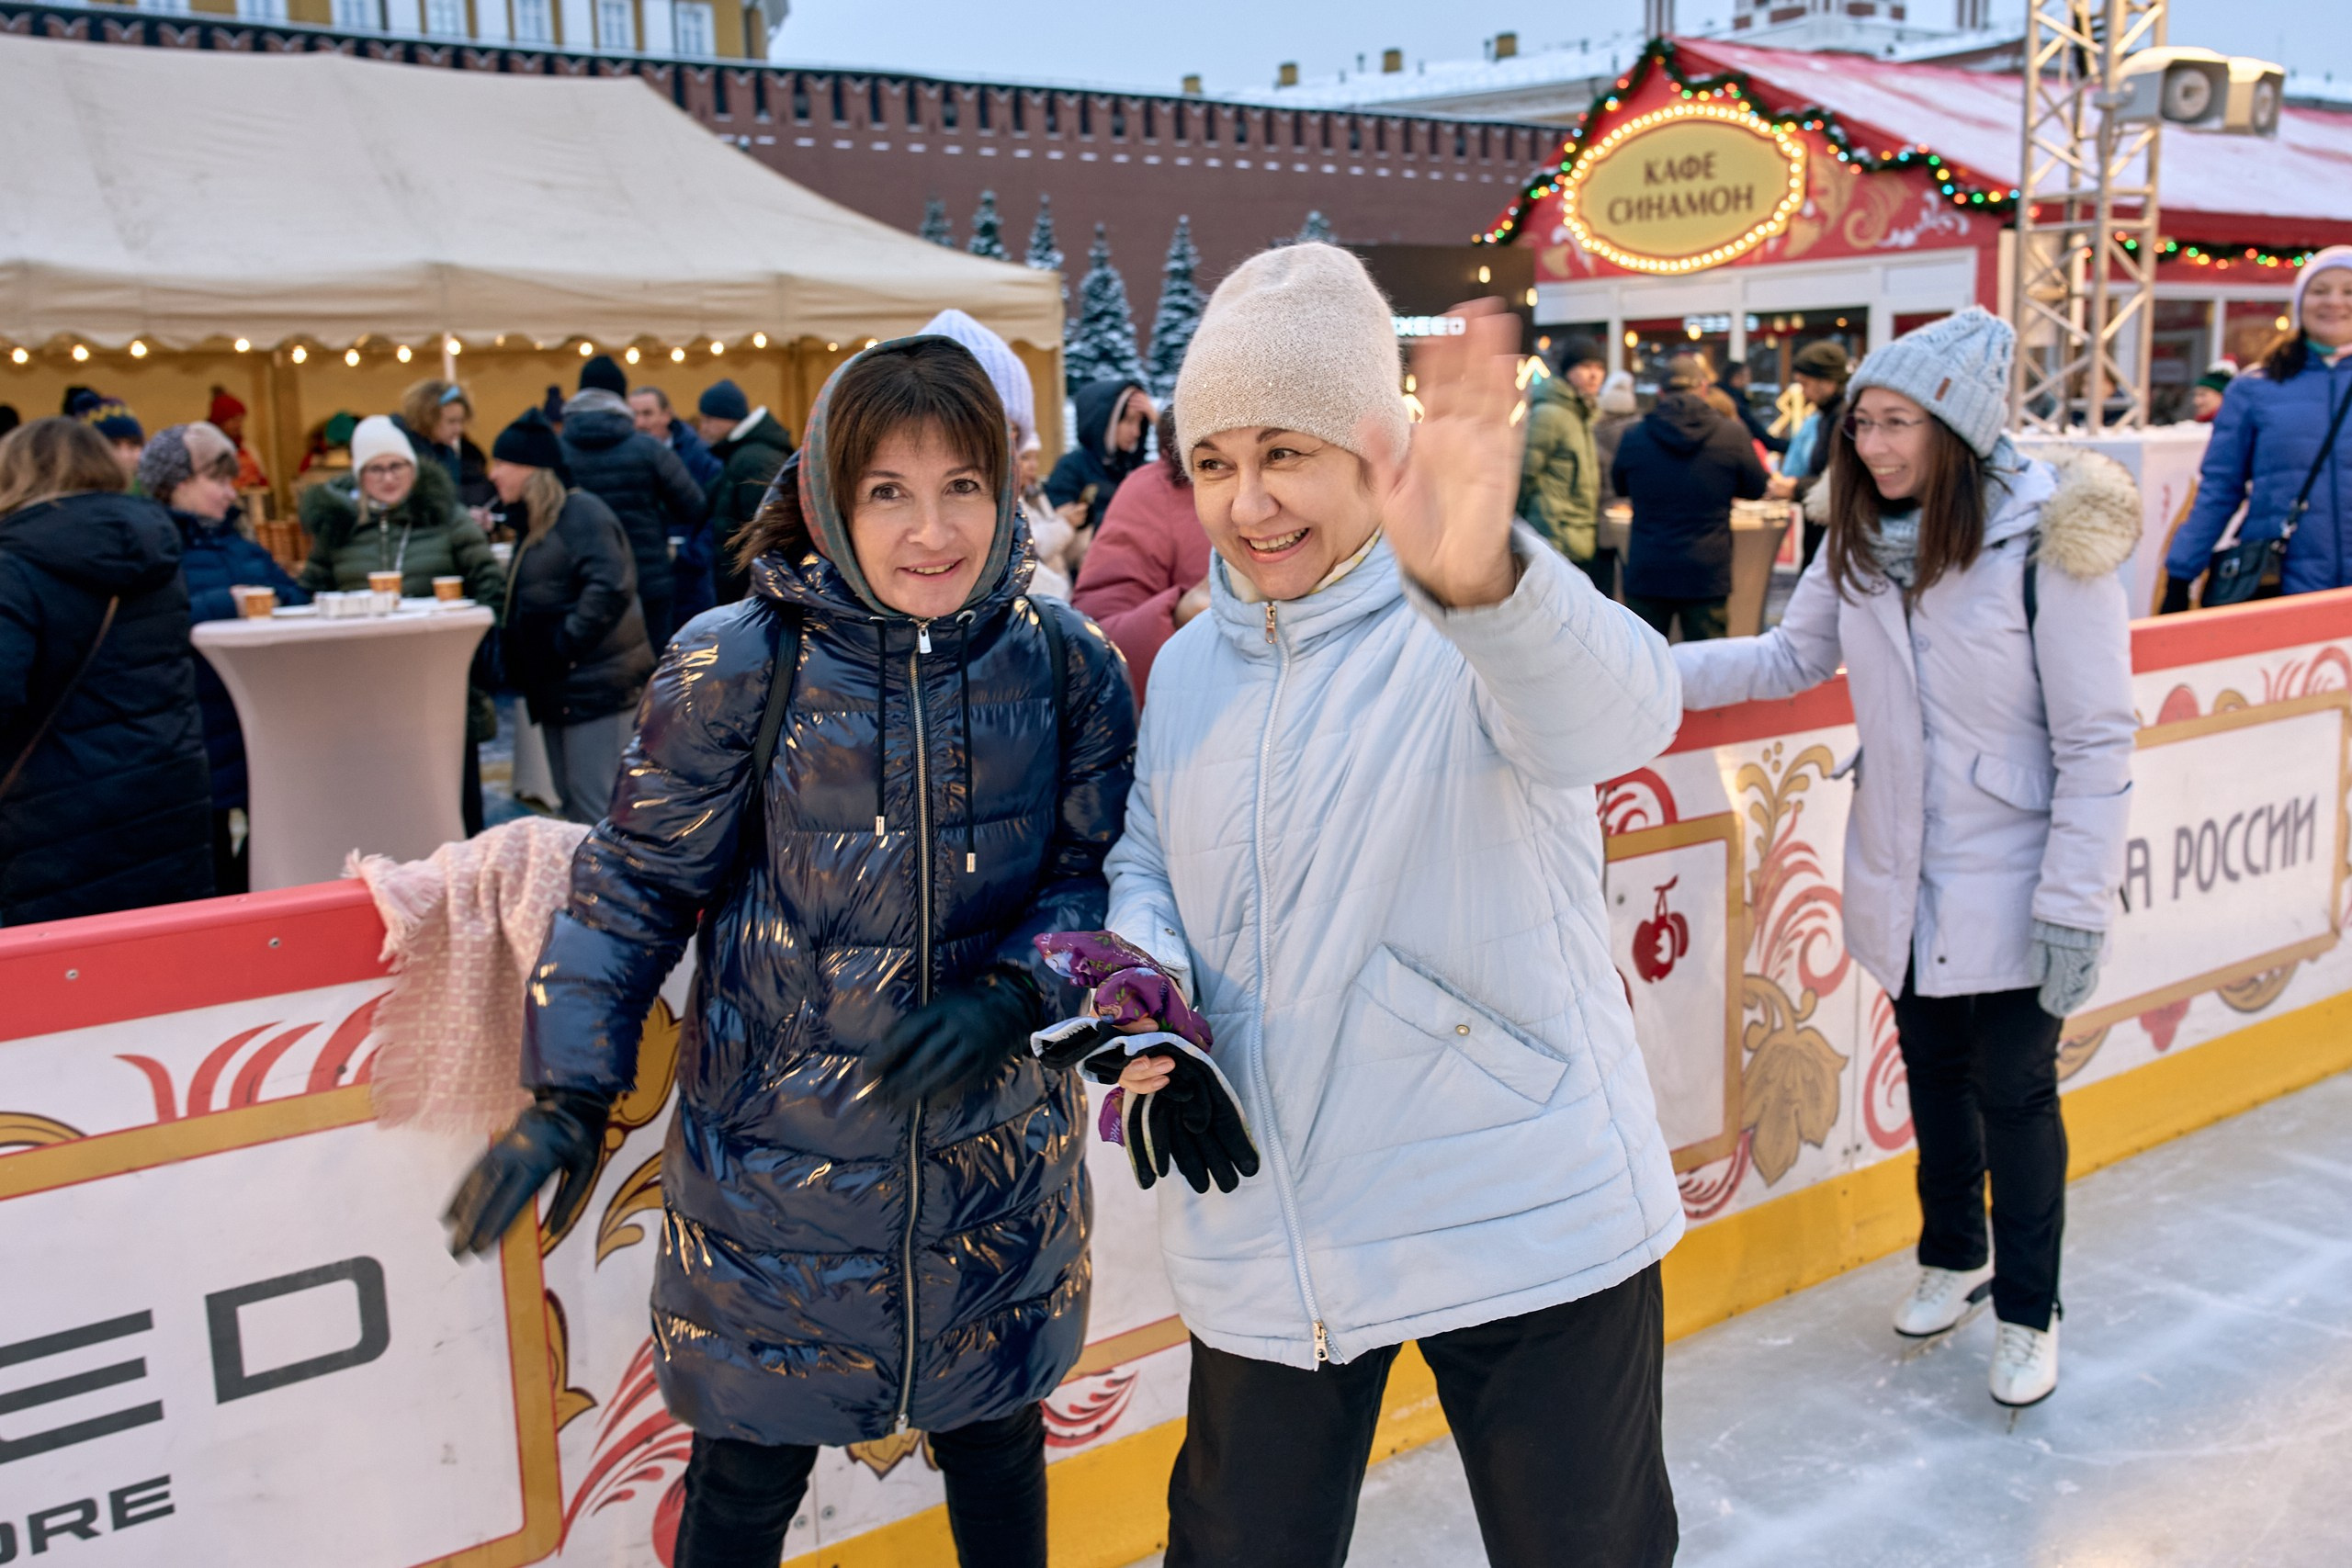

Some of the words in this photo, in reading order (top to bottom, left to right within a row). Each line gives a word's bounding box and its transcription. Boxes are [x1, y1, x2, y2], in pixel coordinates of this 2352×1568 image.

[1644, 151, 1717, 186] КАФЕ
[1608, 185, 1755, 225] СИНАМОН
[1390, 315, 1466, 337] XEED
[2172, 794, 2317, 902] РОССИИ
[0, 1473, 175, 1565] RE
